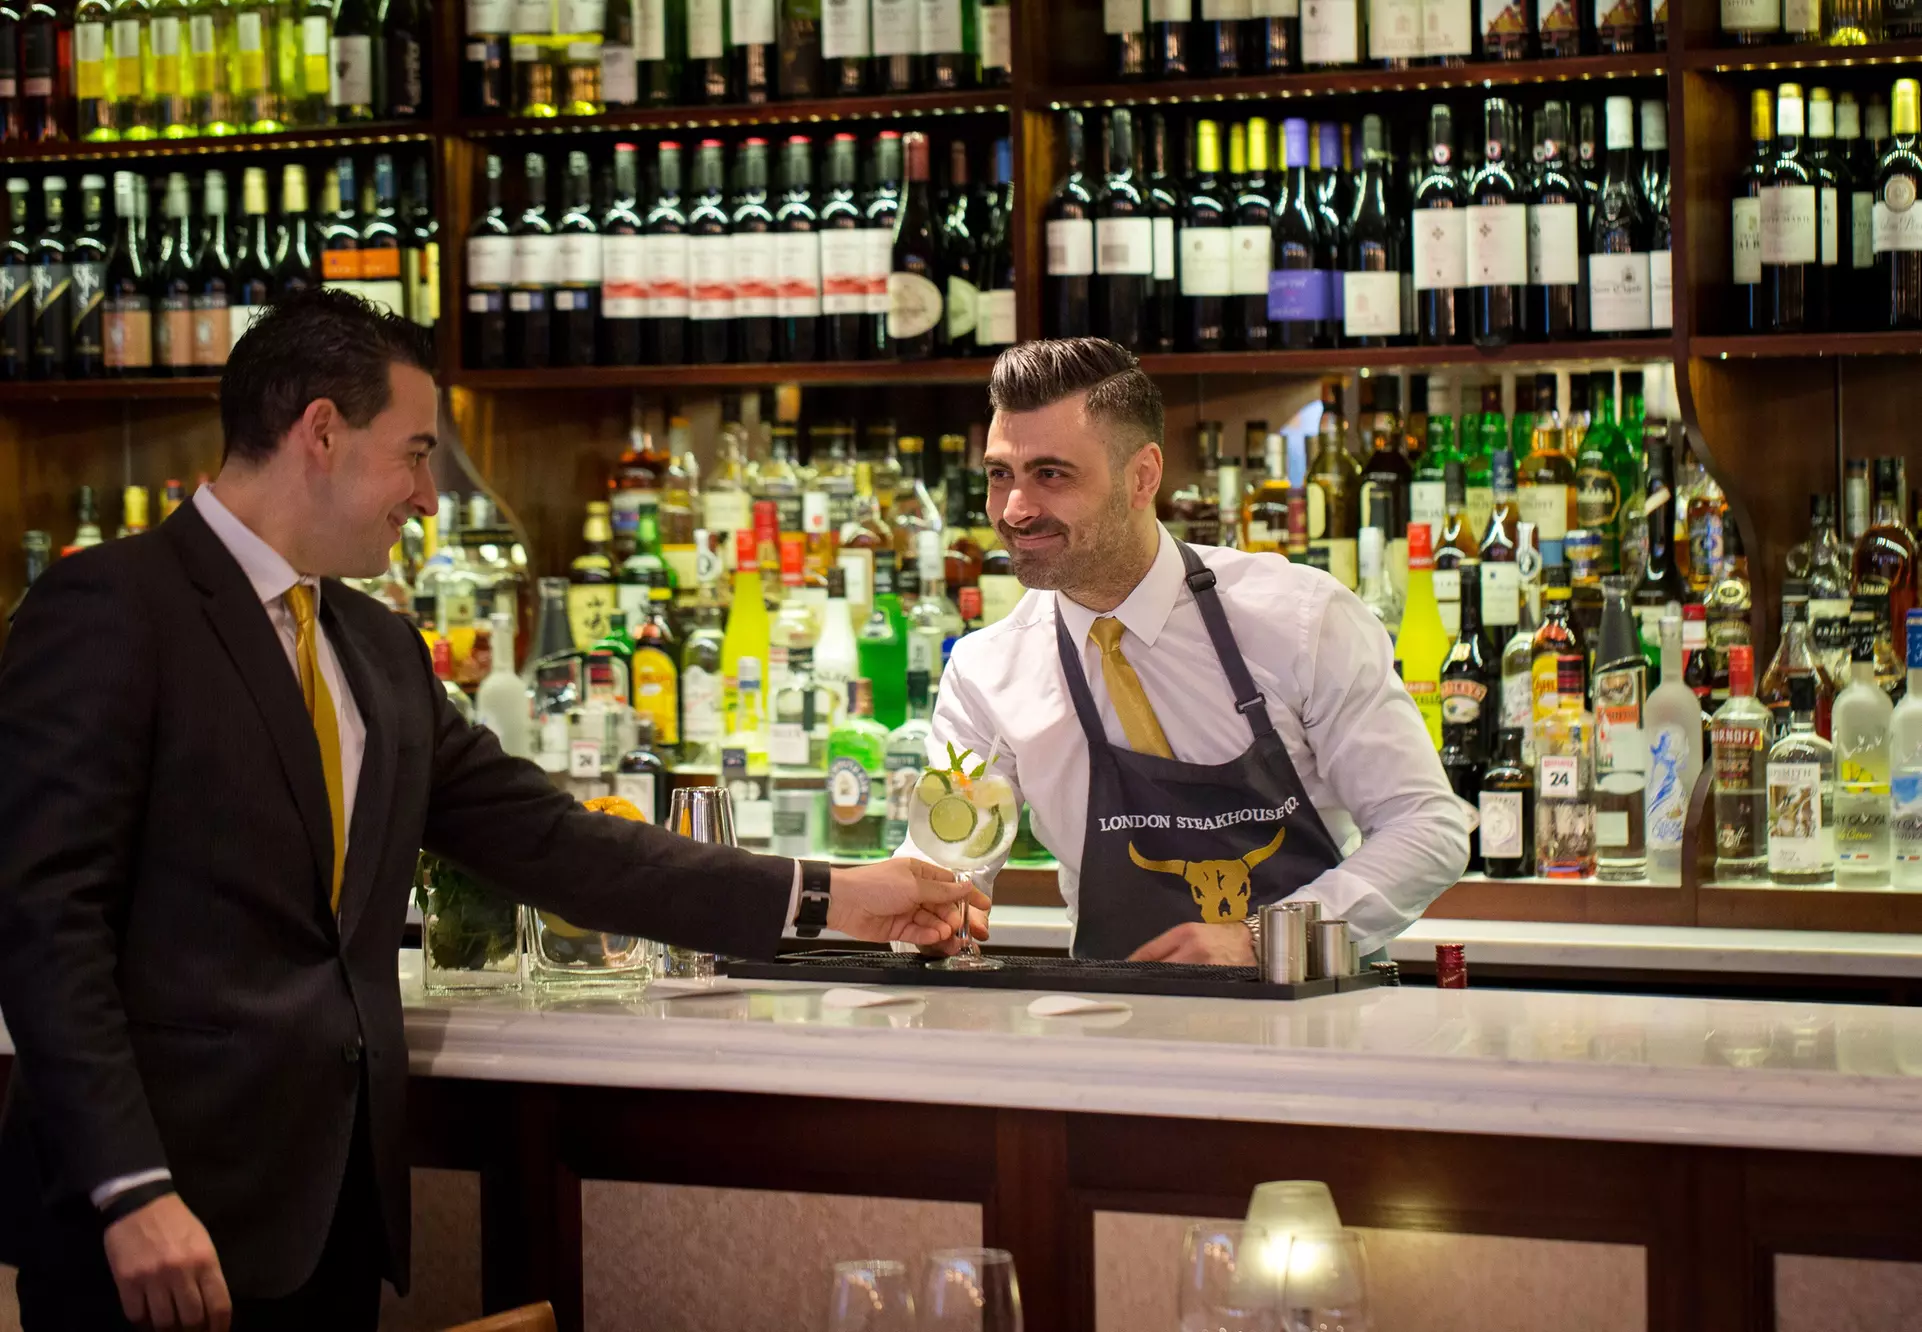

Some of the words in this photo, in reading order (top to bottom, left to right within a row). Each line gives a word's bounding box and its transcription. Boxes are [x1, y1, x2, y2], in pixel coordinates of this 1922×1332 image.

[1549, 771, 1569, 787] 24
[1098, 814, 1171, 832] LONDON
[1176, 806, 1285, 830] STEAKHOUSE
